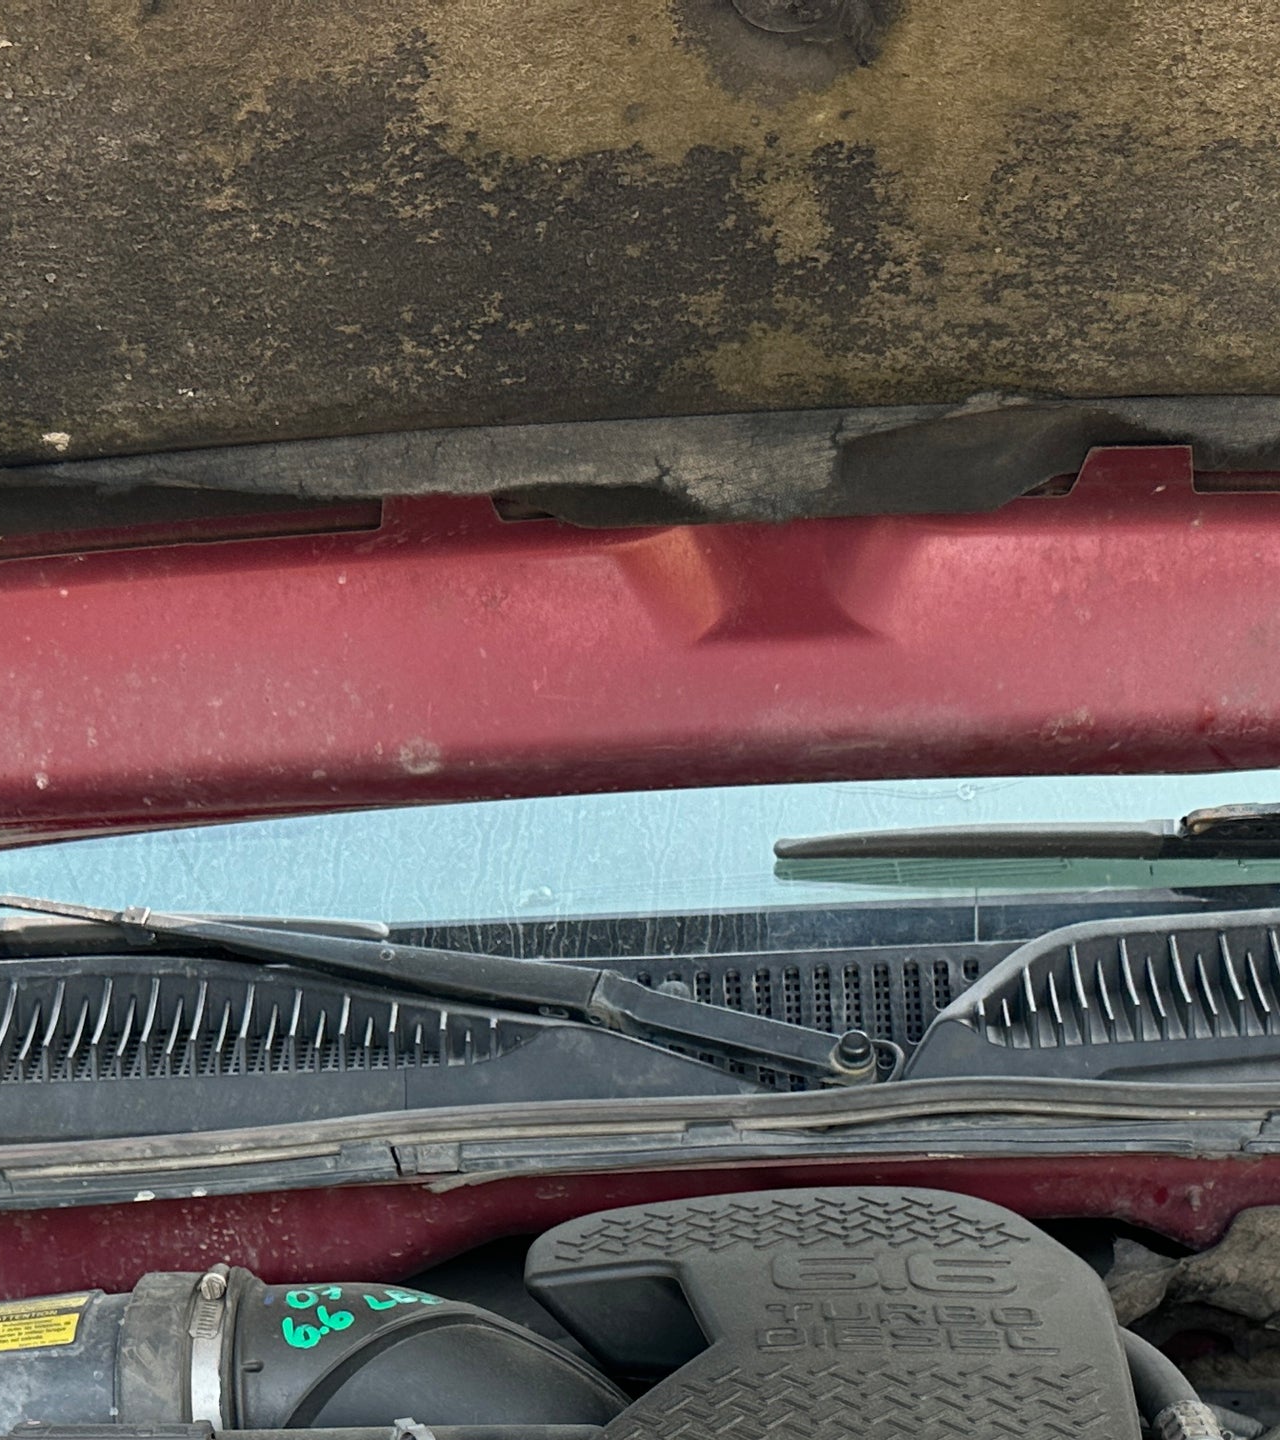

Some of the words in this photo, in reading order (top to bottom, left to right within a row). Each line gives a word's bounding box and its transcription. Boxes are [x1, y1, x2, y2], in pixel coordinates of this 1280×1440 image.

[771, 1251, 1020, 1295] 6.6
[282, 1305, 355, 1349] 6.6
[765, 1302, 1044, 1328] TURBO
[756, 1326, 1061, 1355] DIESEL
